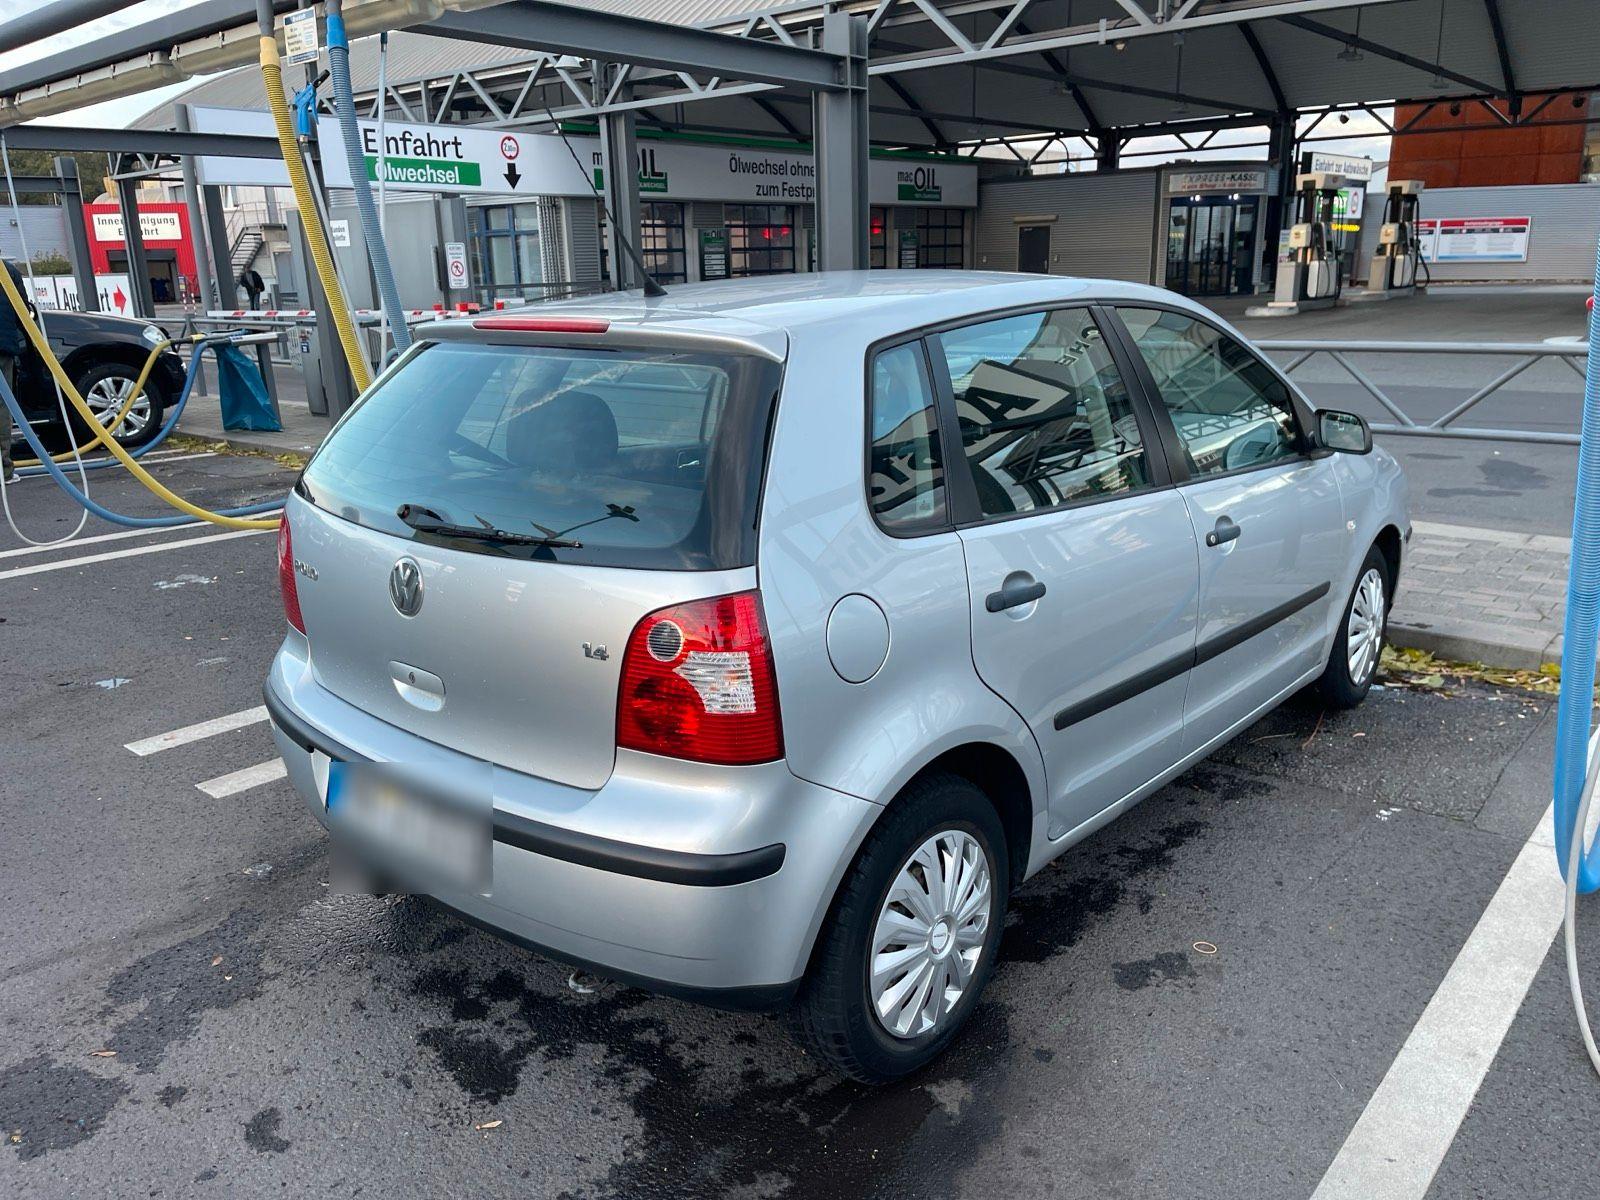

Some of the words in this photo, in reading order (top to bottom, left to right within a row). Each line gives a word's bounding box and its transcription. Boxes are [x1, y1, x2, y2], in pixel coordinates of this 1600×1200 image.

[363, 128, 463, 158] Enfahrt
[729, 152, 787, 175] Ölwechsel
[790, 161, 815, 177] ohne
[756, 184, 779, 196] zum
[914, 167, 939, 190] OIL
[294, 559, 319, 581] POLO
